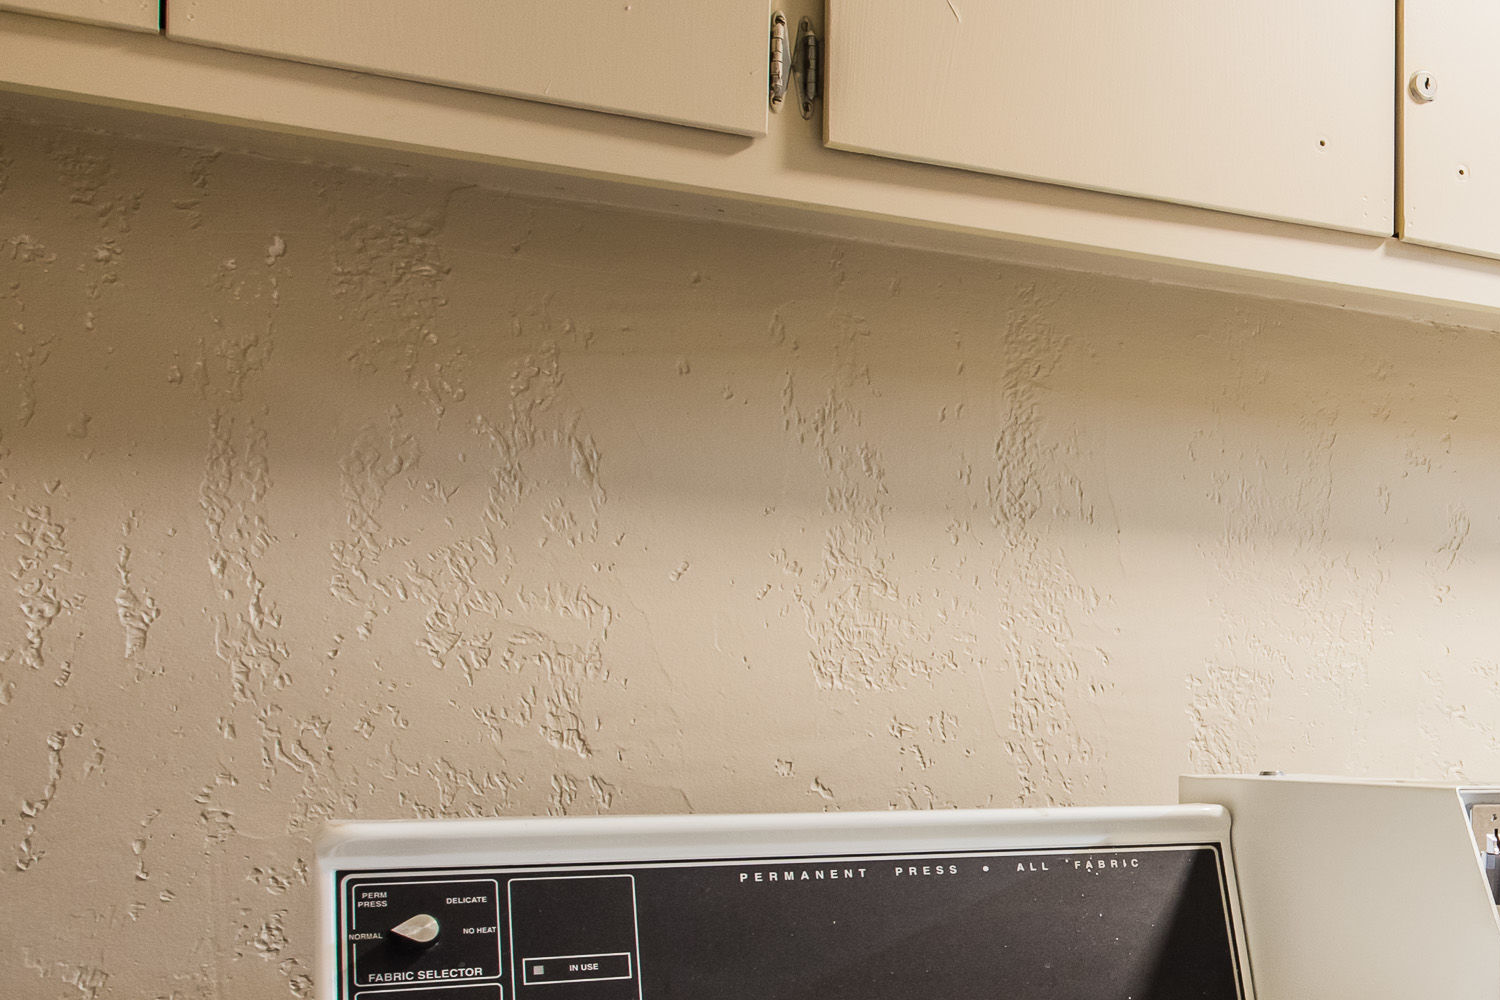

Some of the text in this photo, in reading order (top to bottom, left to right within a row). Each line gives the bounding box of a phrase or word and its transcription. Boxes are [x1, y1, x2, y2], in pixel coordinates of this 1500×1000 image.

[739, 858, 1139, 883] PERMANENT PRESS ALL FABRIC
[361, 890, 387, 900] PERM
[445, 895, 488, 905] DELICATE
[357, 899, 388, 908] PRESS
[462, 925, 497, 935] NO HEAT
[348, 932, 383, 941] NORMAL
[569, 962, 599, 972] IN USE
[368, 966, 483, 983] FABRIC SELECTOR
